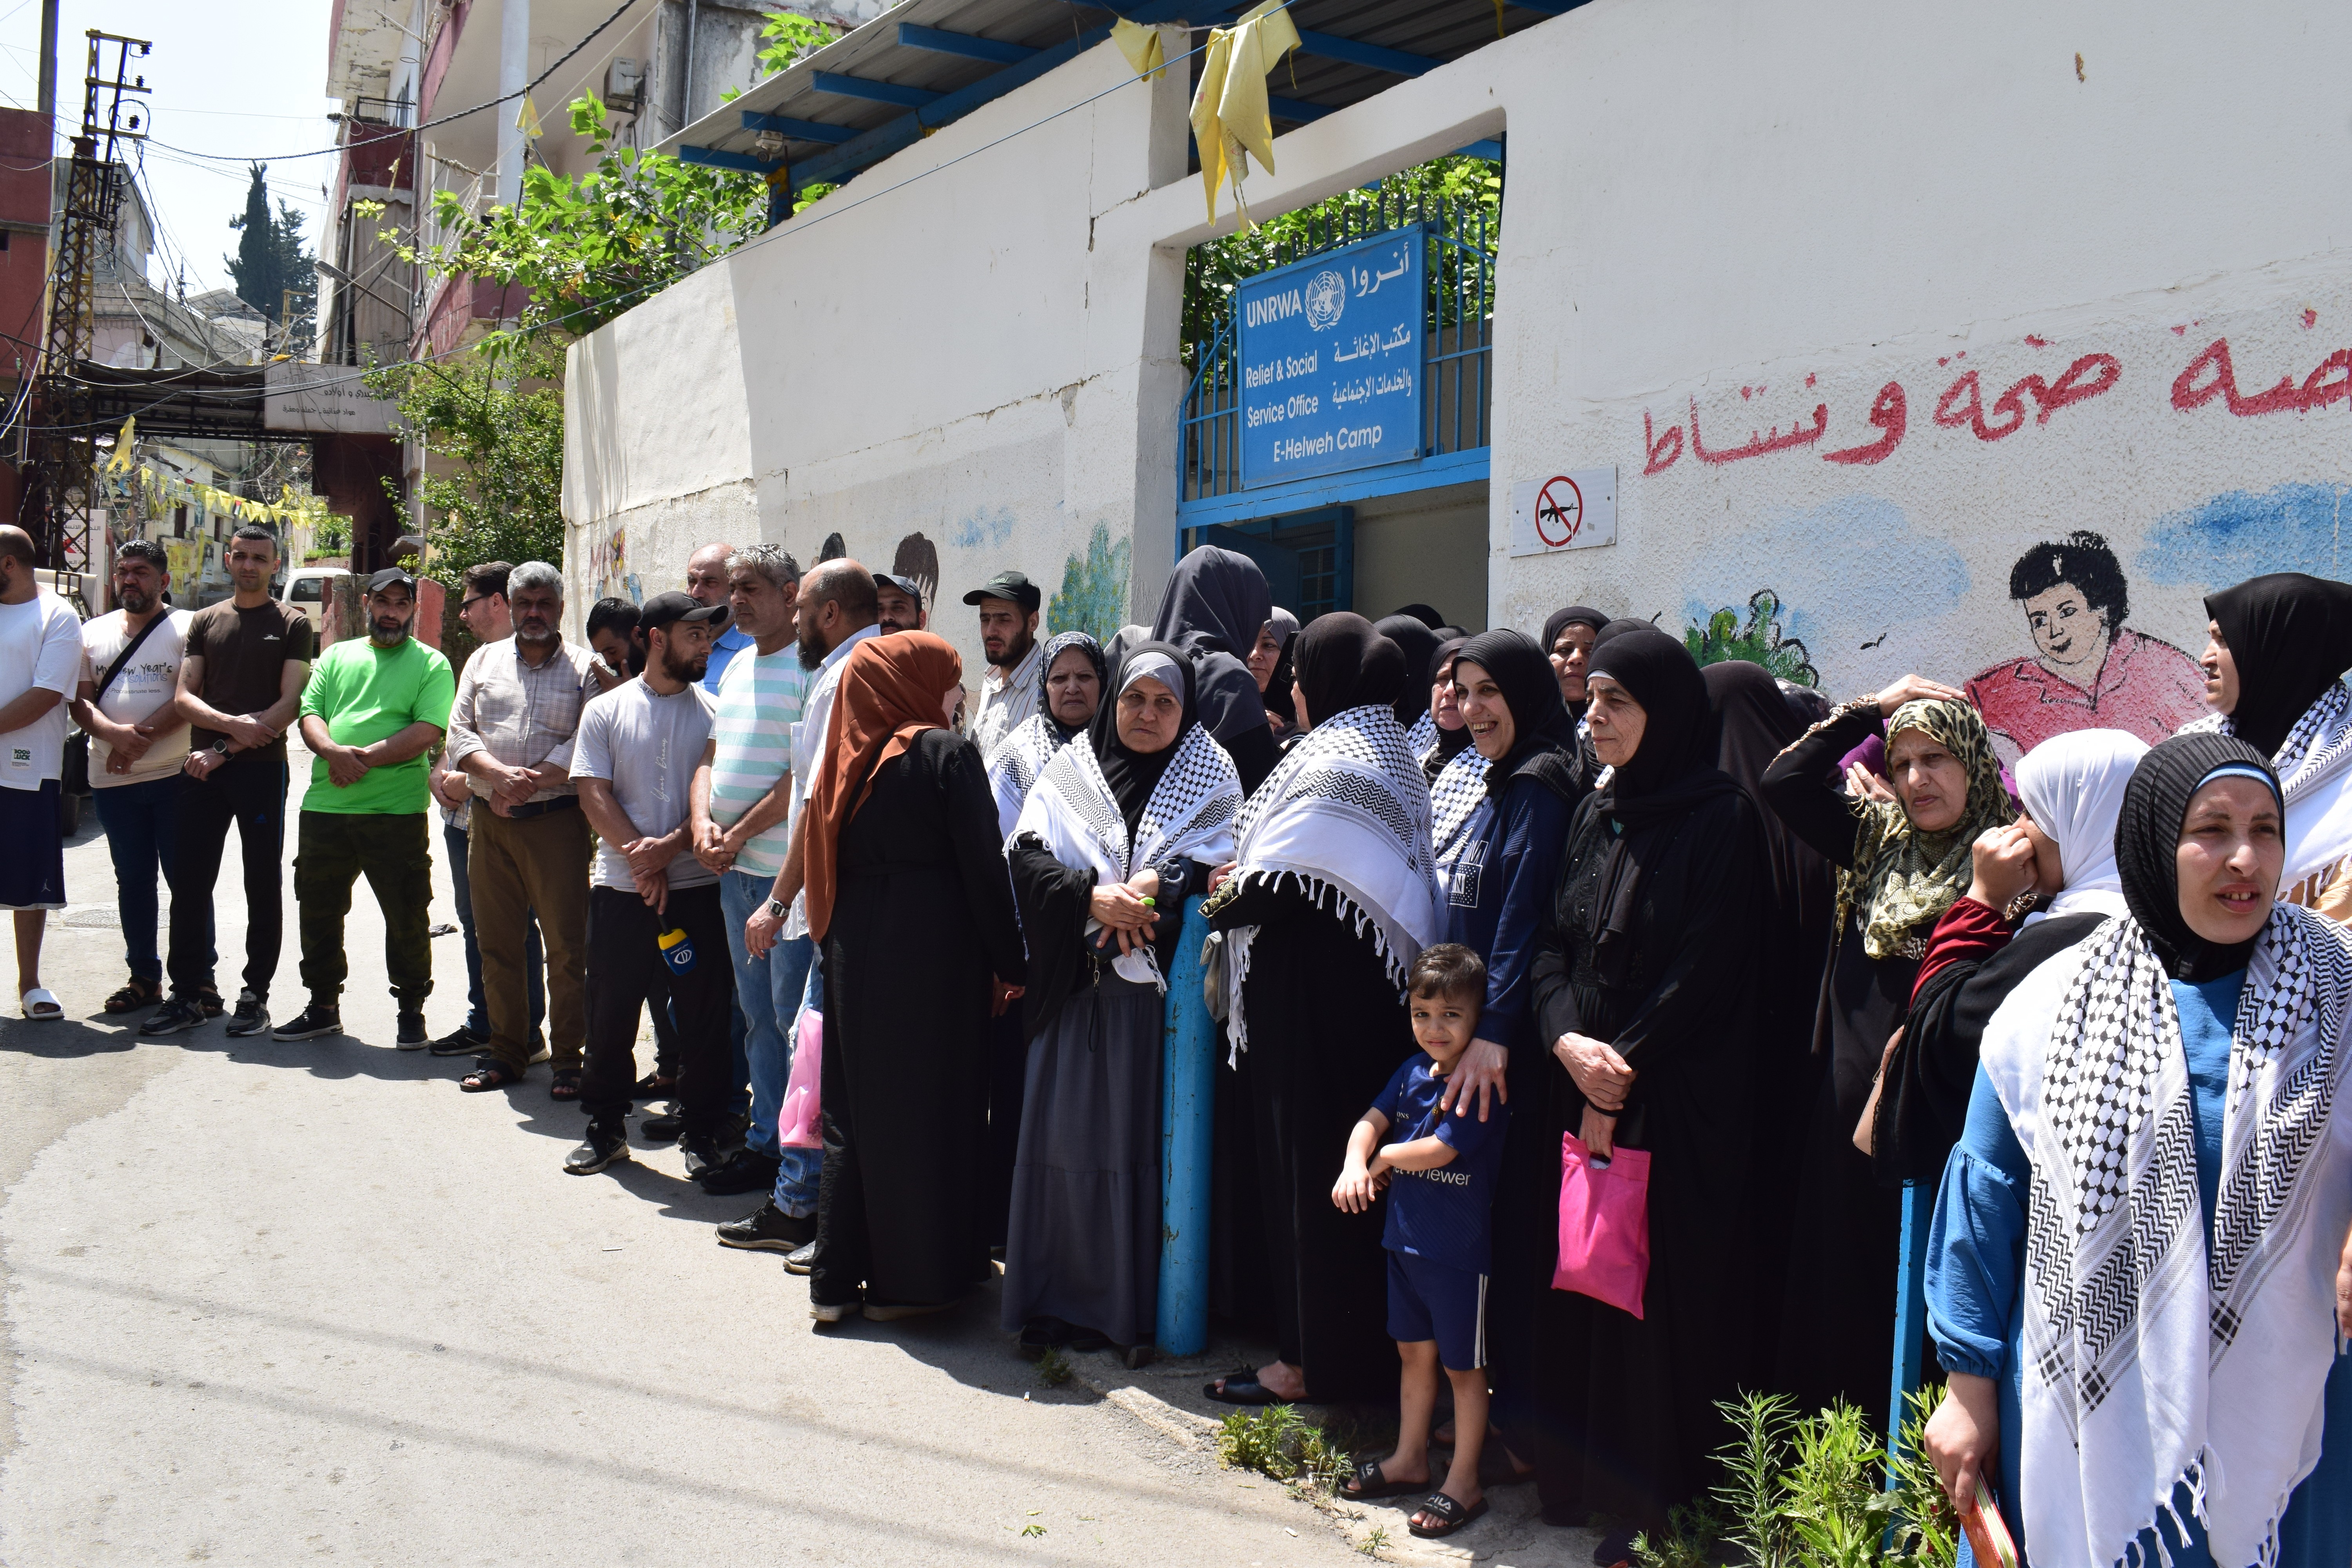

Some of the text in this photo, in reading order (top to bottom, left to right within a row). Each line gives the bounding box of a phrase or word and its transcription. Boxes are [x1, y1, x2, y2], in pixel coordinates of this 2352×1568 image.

[1352, 243, 1408, 296] أنروا
[1247, 289, 1302, 328] UNRWA
[1382, 323, 1410, 357] مكتب
[1246, 350, 1317, 388] Relief & Social
[1376, 367, 1411, 397] والخدمات
[1248, 394, 1318, 428] Service Office
[1274, 425, 1382, 462] E-Helweh Camp
[121, 666, 136, 675] ew
[140, 662, 172, 674] Year's
